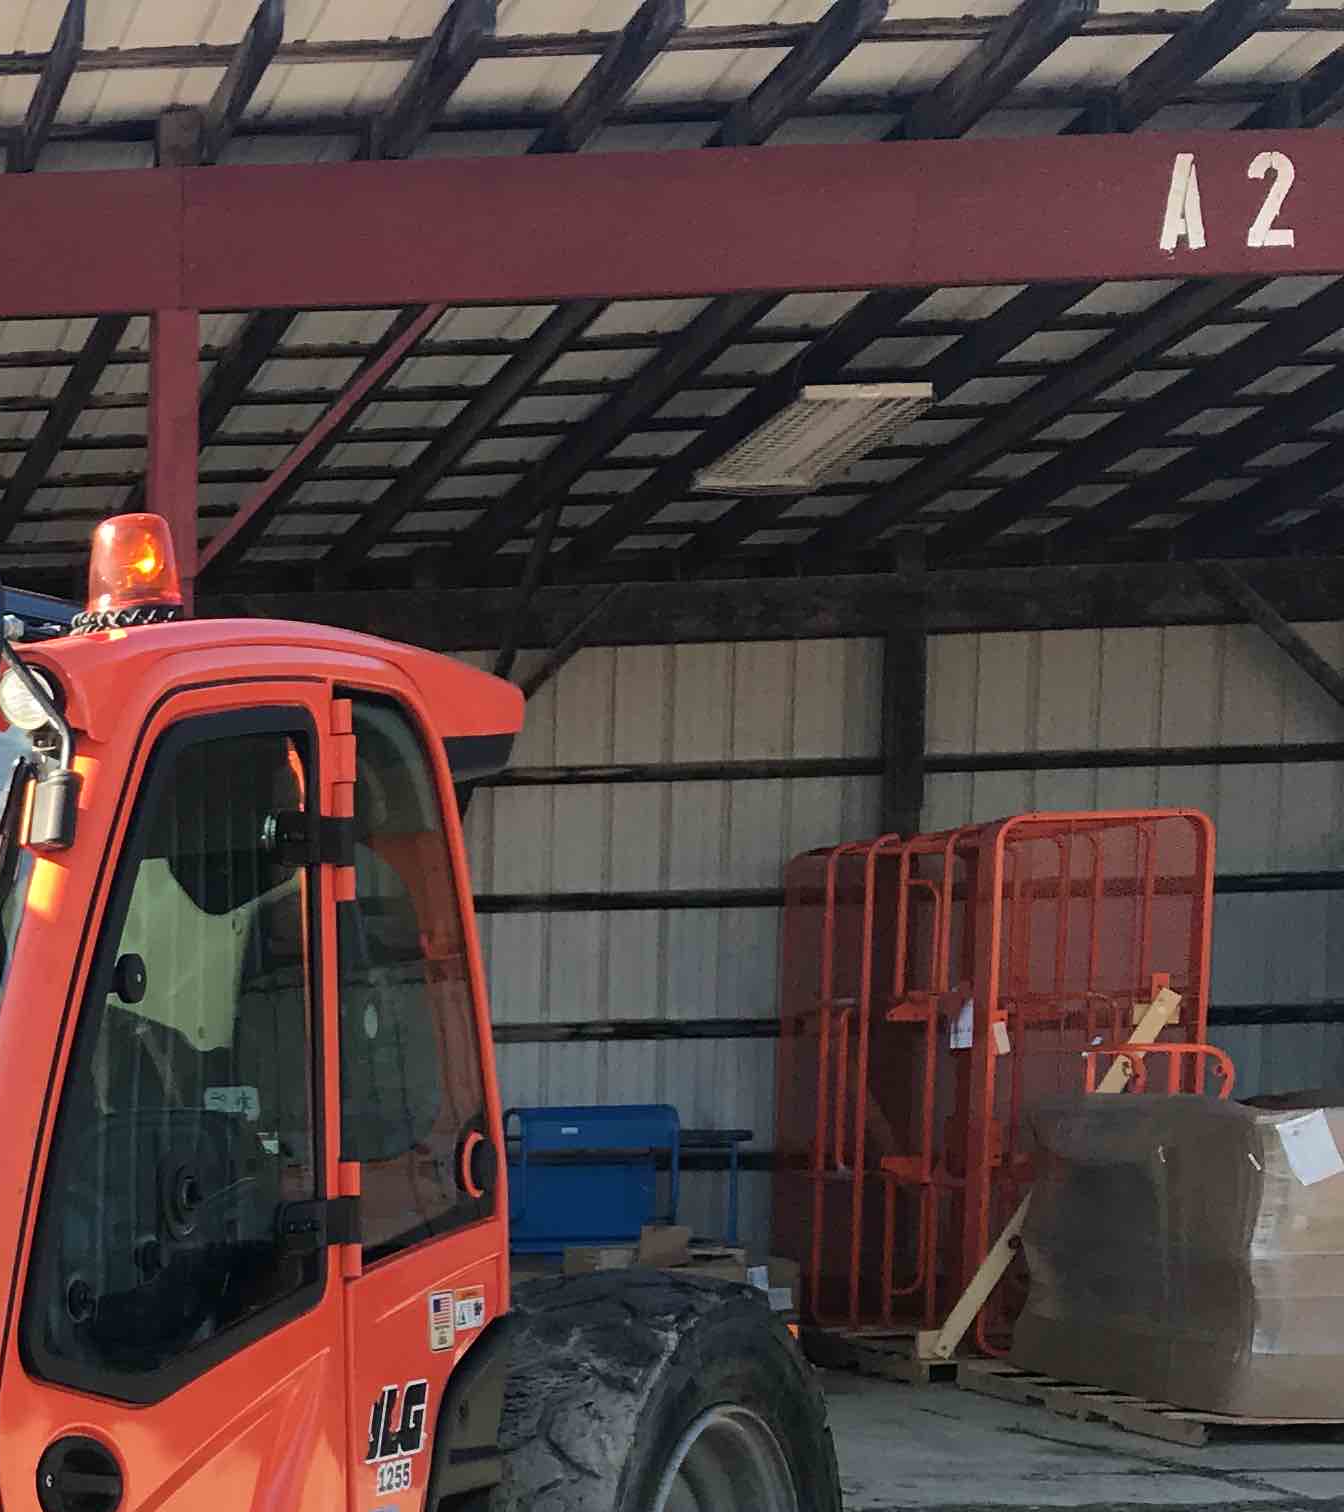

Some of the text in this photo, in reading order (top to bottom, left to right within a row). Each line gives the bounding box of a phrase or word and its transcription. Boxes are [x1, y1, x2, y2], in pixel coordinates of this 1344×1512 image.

[1159, 151, 1296, 251] A 2
[363, 1378, 430, 1464] JLG
[378, 1462, 410, 1492] 1255
